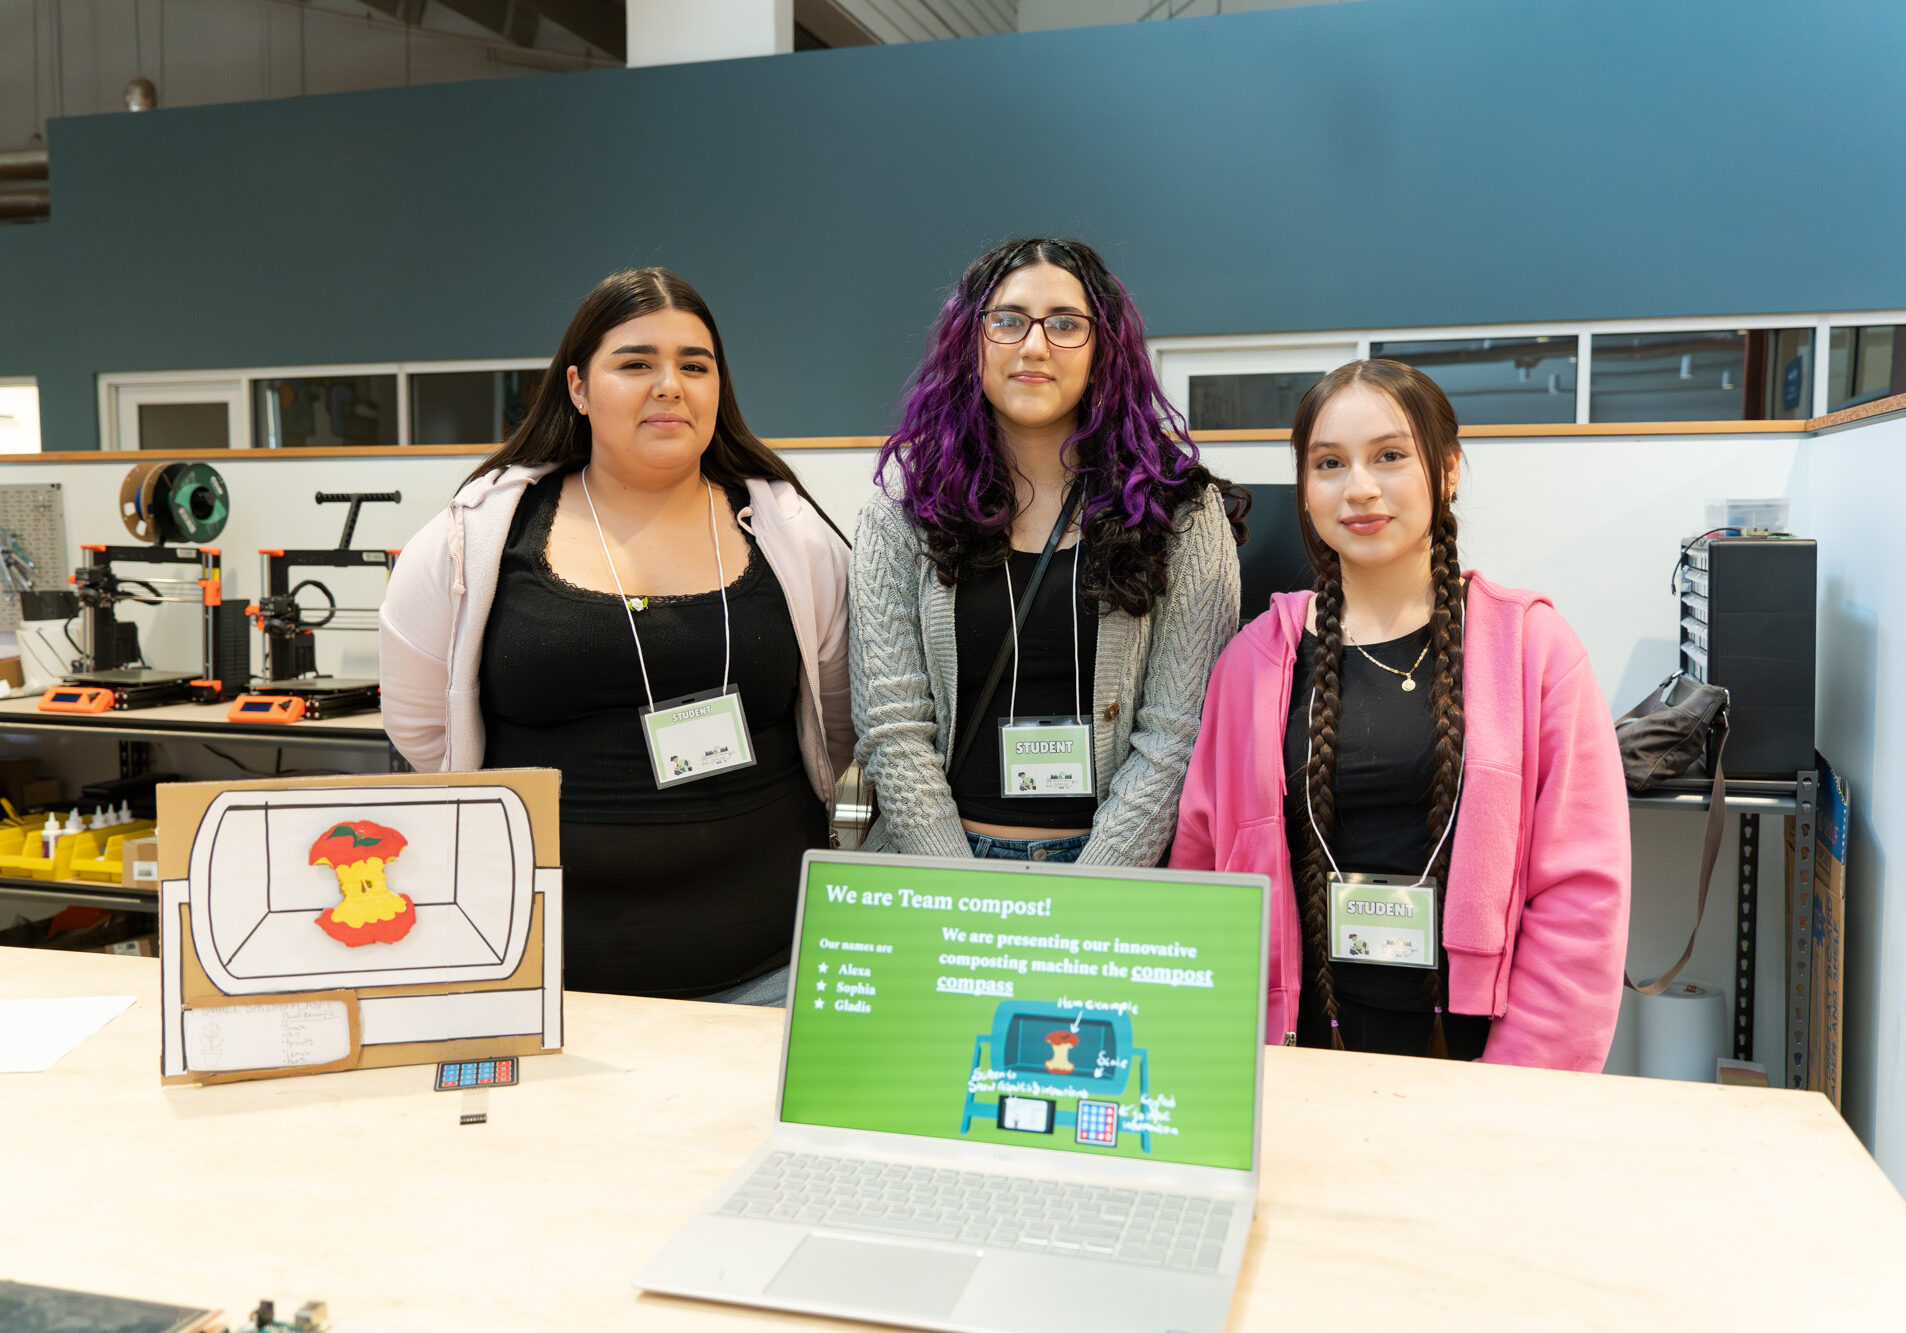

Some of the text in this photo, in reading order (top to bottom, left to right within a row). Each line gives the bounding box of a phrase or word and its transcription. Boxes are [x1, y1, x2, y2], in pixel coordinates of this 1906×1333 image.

[672, 705, 712, 722] STUDENT
[1016, 740, 1073, 754] STUDENT
[826, 884, 1052, 919] We are Team compost!
[1347, 900, 1415, 918] STUDENT
[819, 938, 893, 954] Our names are
[942, 927, 1197, 959] We are presenting our innovative
[838, 963, 871, 977] Alexa
[938, 953, 1214, 985] composting machine the compost
[836, 981, 876, 997] Sophia
[937, 975, 1014, 996] compass
[834, 999, 871, 1014] Gladis
